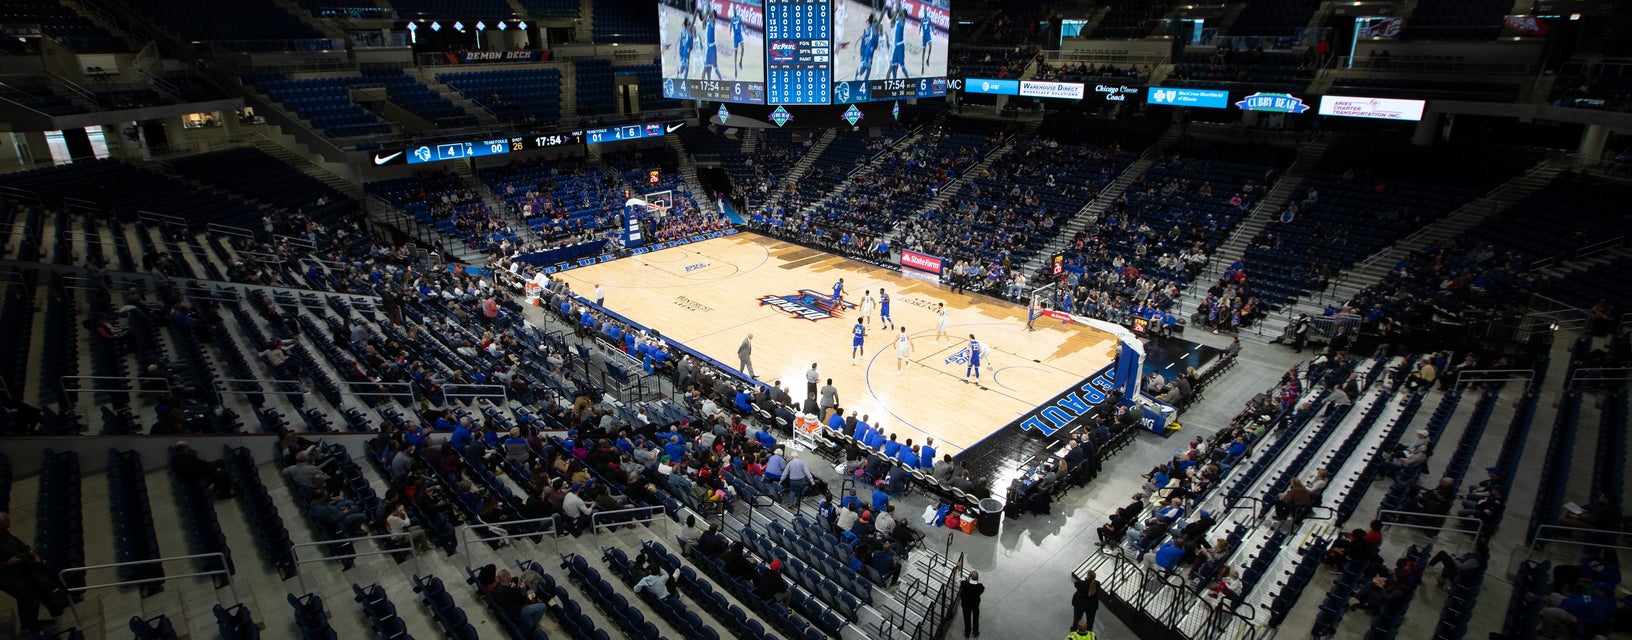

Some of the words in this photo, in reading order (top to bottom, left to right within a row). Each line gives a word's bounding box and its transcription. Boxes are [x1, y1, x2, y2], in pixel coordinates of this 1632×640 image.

[466, 52, 501, 61] DEMON
[507, 51, 532, 60] DECK
[680, 81, 686, 91] 4
[700, 81, 719, 91] 17:54
[735, 83, 741, 95] 6
[859, 82, 866, 94] 4
[884, 80, 905, 90] 17:54
[921, 79, 926, 91] 6
[1096, 85, 1118, 93] Chicago
[1248, 97, 1272, 107] CUBBY
[1275, 98, 1296, 110] BEAR
[629, 128, 634, 136] 6
[536, 135, 561, 146] 17:54
[592, 134, 602, 142] 01
[447, 146, 455, 156] 4
[467, 147, 473, 155] 4
[492, 144, 502, 153] 00
[513, 142, 523, 150] 26
[633, 229, 739, 255] DEMONS
[543, 254, 616, 274] BLUE
[1020, 374, 1114, 438] EPAUL
